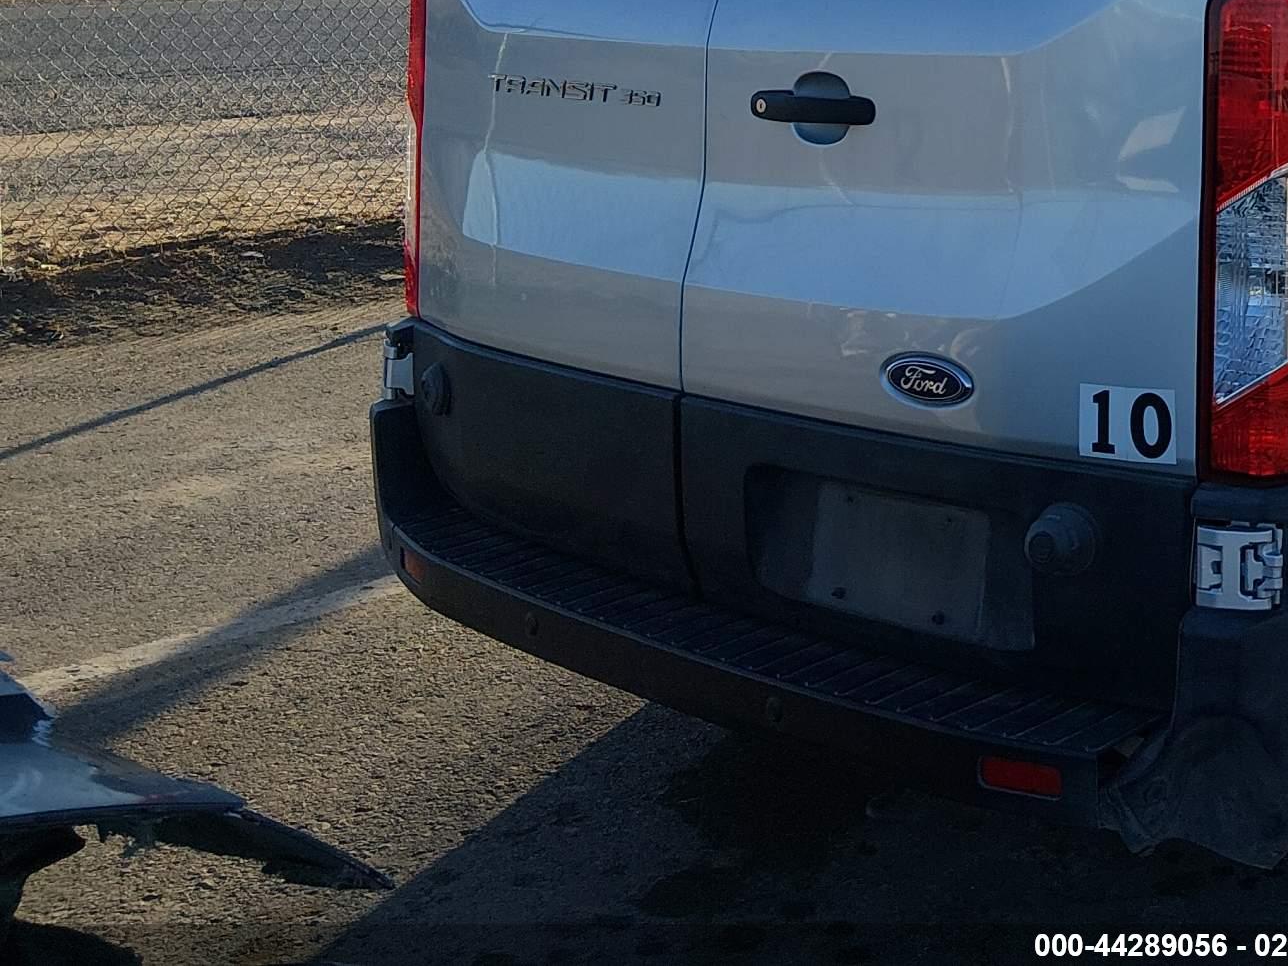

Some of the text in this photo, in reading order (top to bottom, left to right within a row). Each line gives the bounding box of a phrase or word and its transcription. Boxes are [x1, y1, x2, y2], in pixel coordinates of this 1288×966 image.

[488, 73, 662, 107] TRANSIT 350
[900, 365, 949, 395] Ford
[1091, 389, 1172, 459] 10
